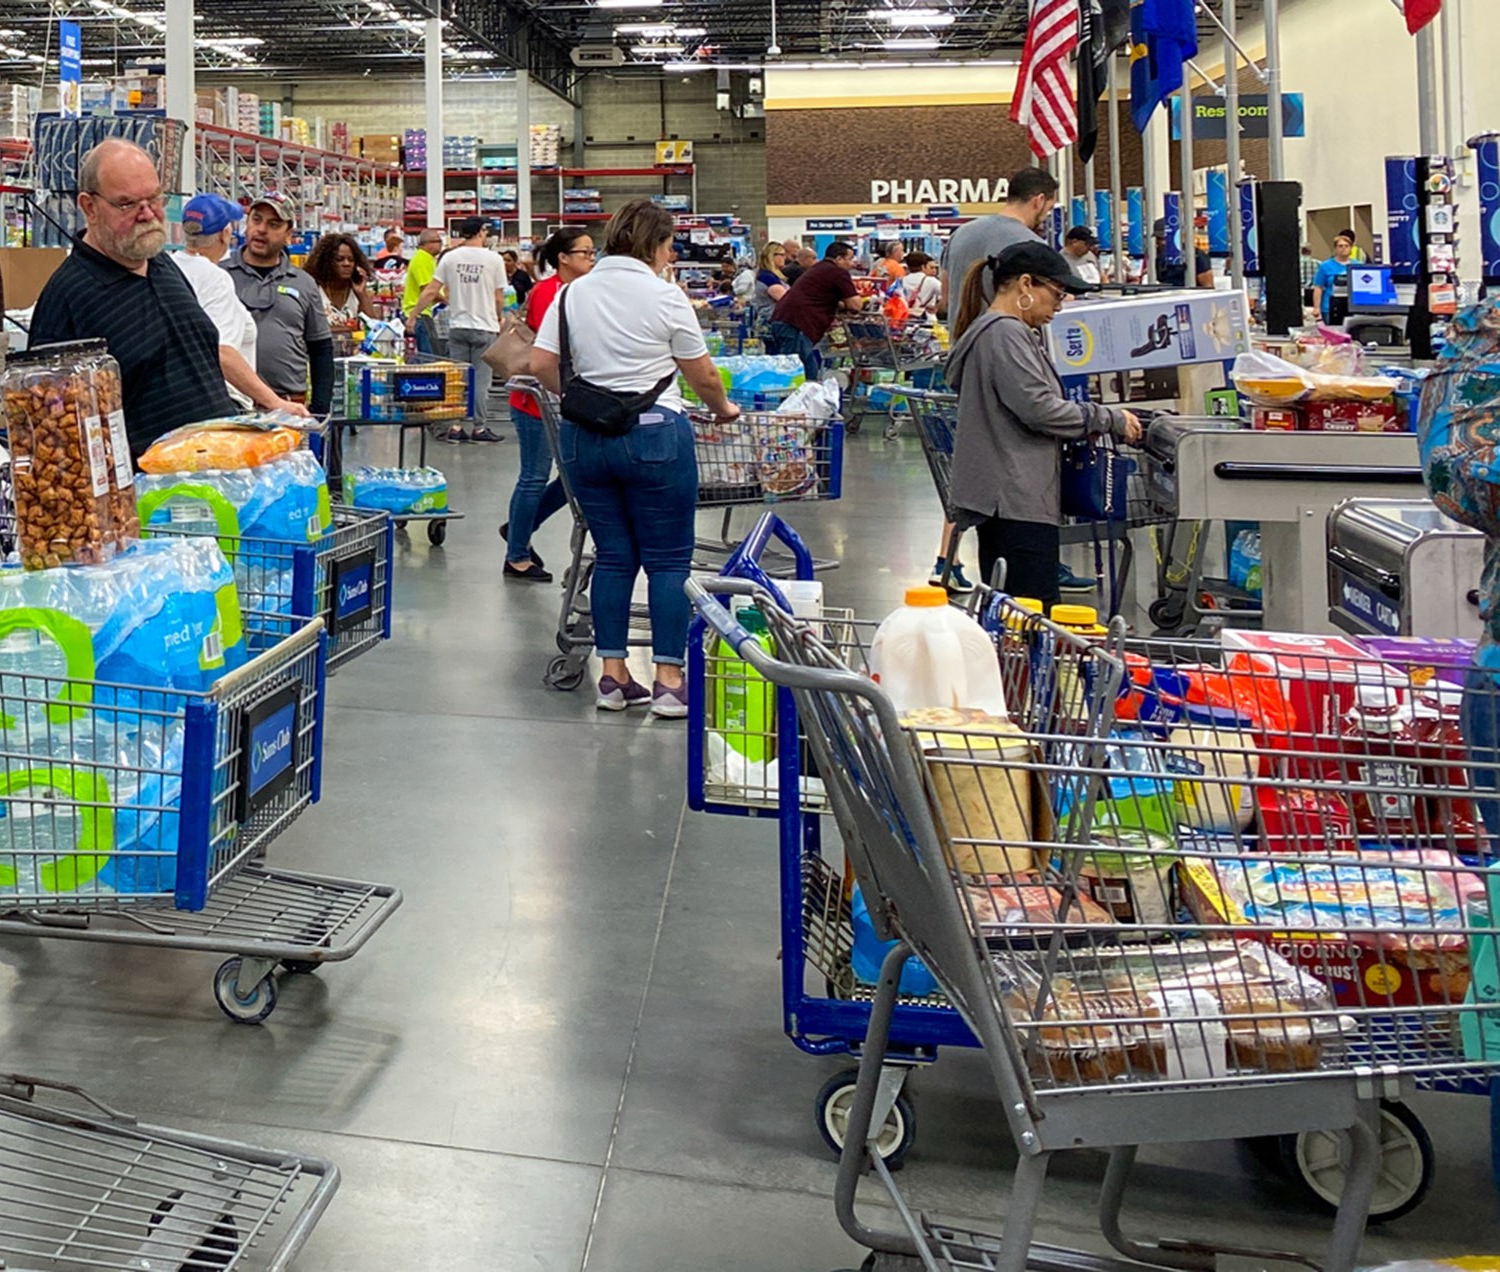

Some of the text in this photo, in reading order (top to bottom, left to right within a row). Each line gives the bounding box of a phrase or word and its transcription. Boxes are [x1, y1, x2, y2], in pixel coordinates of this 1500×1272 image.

[1195, 105, 1268, 117] Resoom
[456, 263, 485, 274] STREET
[459, 273, 480, 283] TEAM
[1066, 327, 1084, 358] Serta
[276, 725, 290, 751] Club
[1270, 943, 1362, 960] IGIORNO
